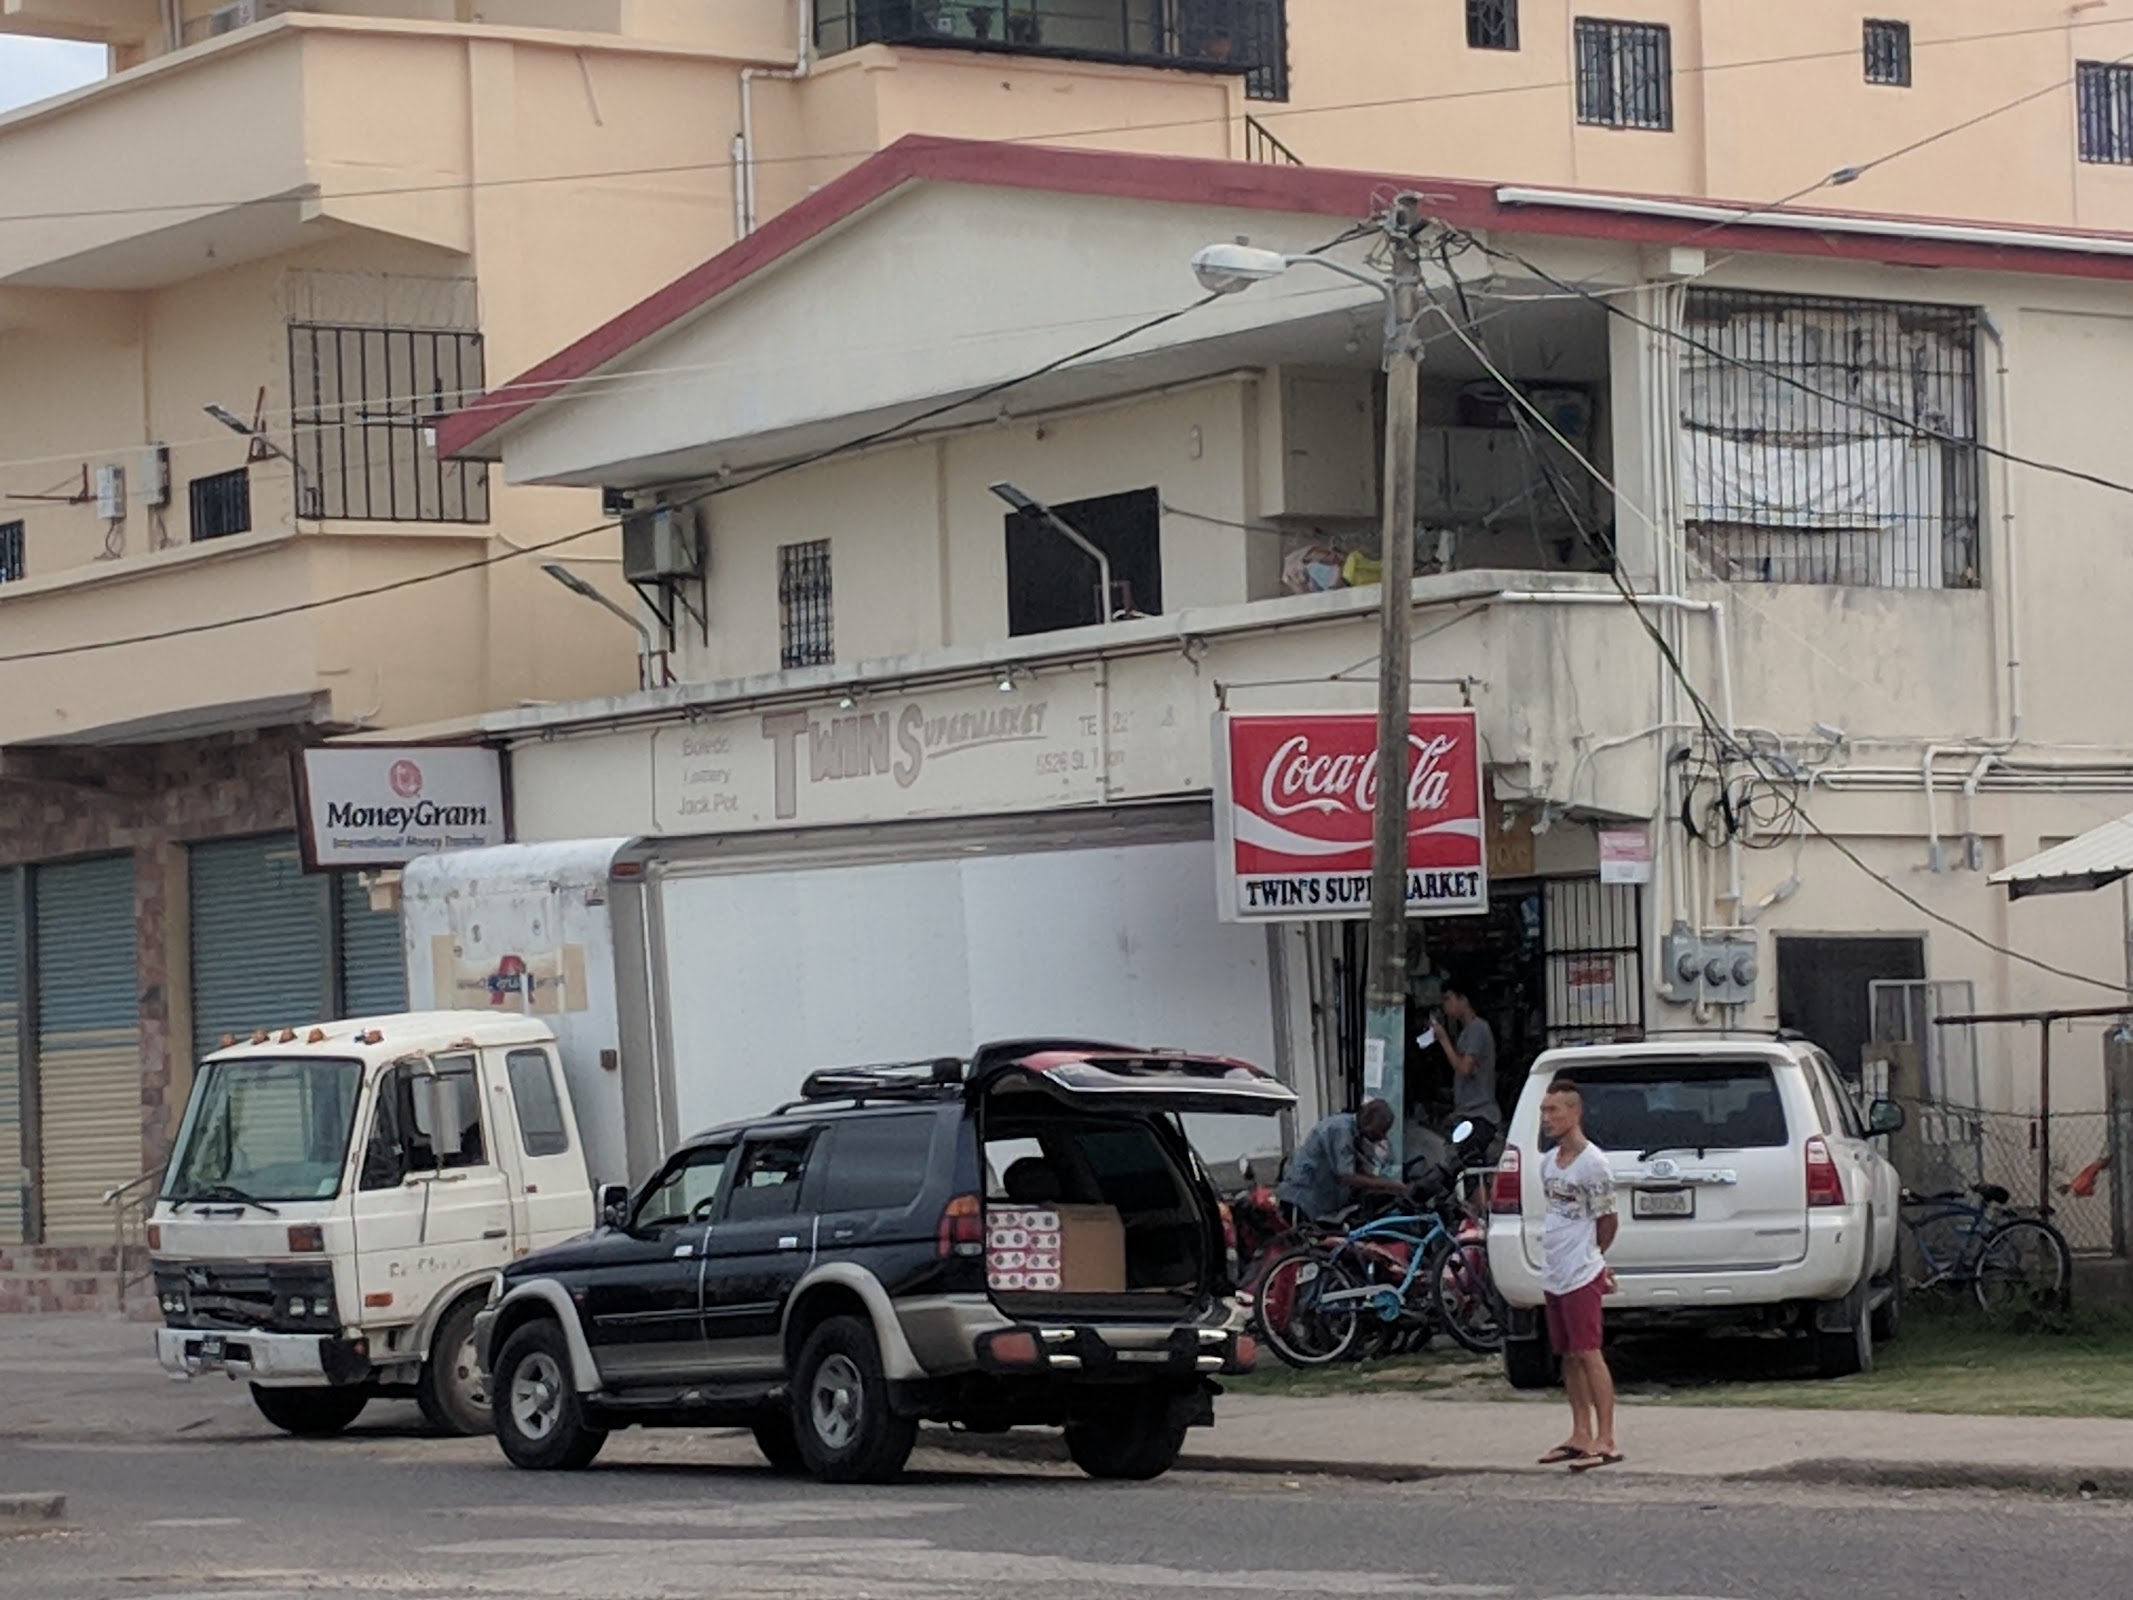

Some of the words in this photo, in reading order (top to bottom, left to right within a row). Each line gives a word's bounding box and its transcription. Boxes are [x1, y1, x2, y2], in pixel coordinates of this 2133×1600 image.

[1262, 735, 1459, 815] Coca-Cla
[327, 800, 487, 833] MoneyGram
[406, 834, 442, 850] Money
[1246, 878, 1320, 906] TWIN'S
[1324, 871, 1478, 904] SUPARKET
